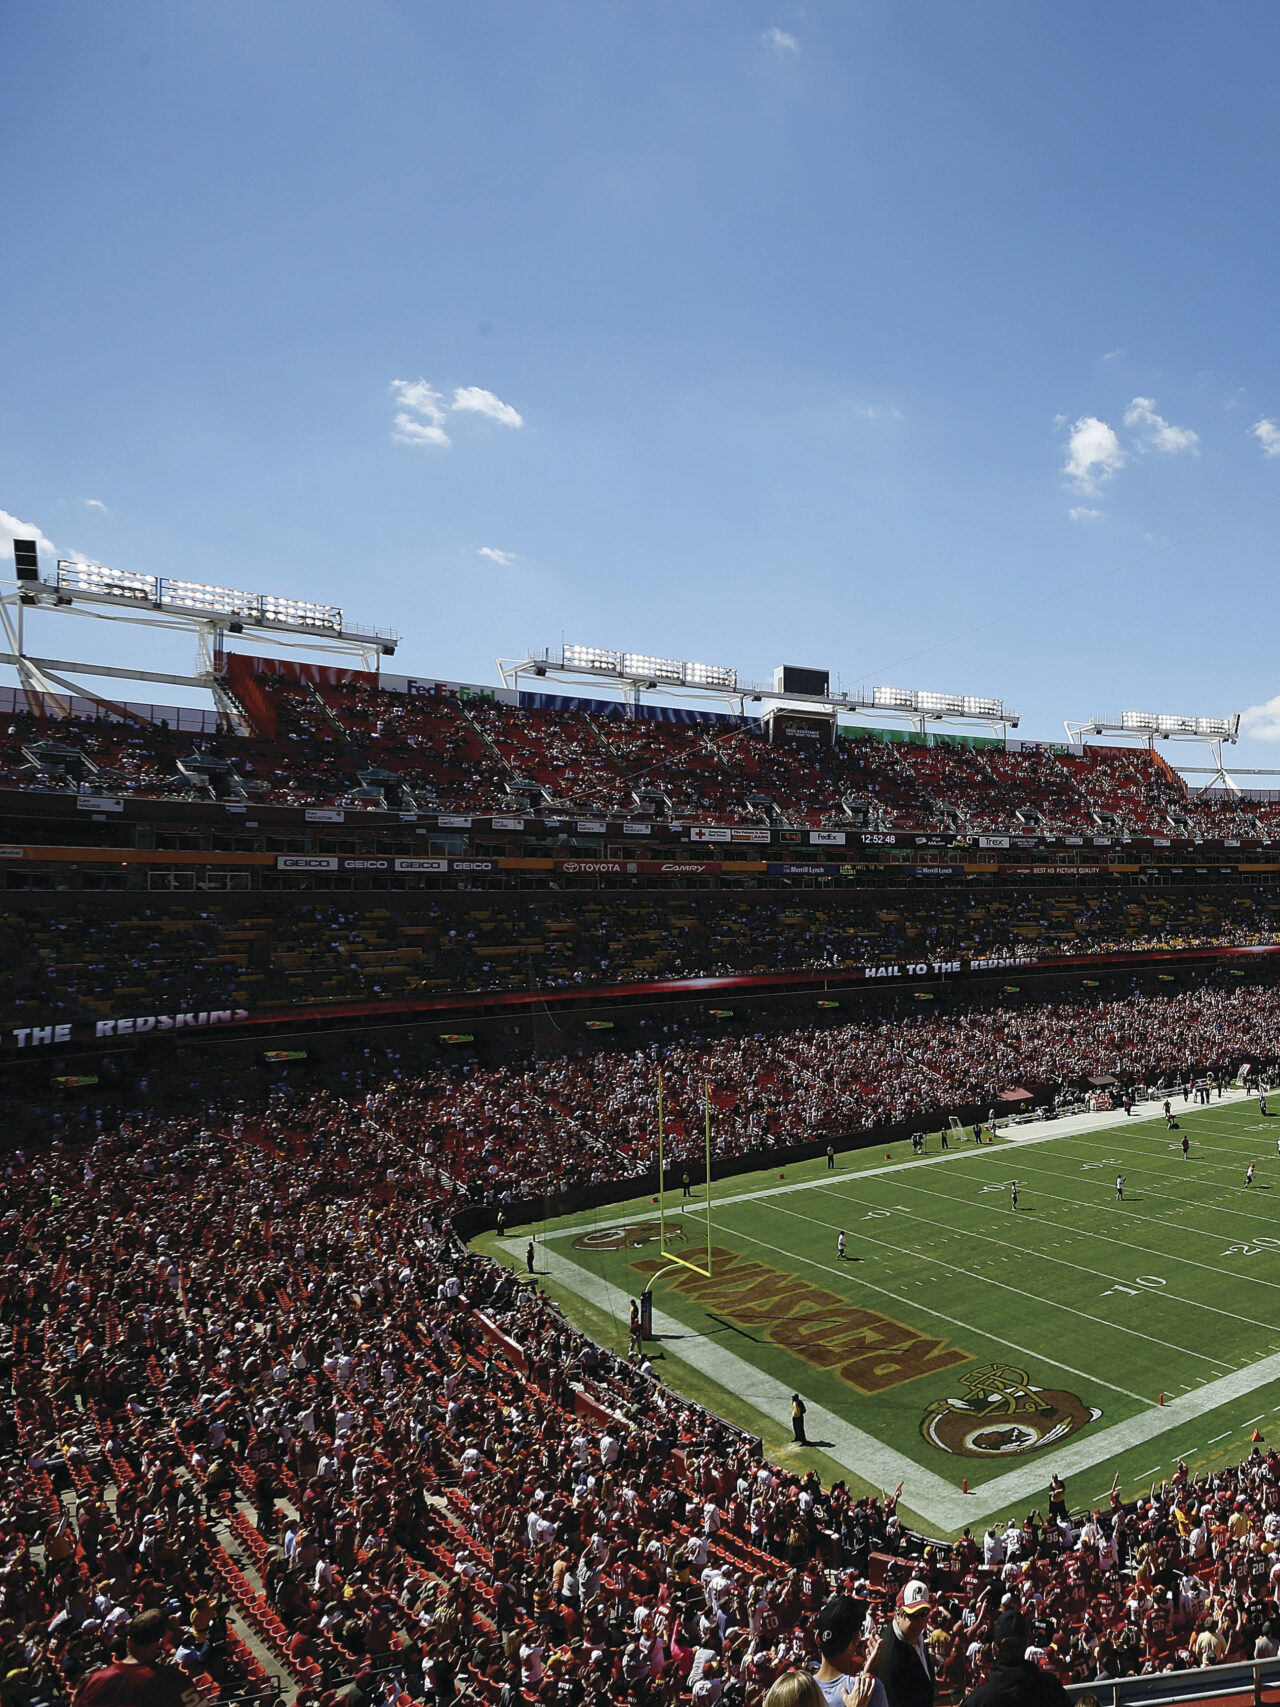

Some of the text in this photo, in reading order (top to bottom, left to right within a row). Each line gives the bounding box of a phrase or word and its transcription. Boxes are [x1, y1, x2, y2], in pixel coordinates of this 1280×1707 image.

[861, 834, 896, 843] 12:52:48
[985, 838, 1002, 846] Trex
[283, 859, 330, 868] GEICO
[344, 860, 388, 869] GEICO
[400, 860, 441, 870] GEICO
[453, 862, 492, 870] GEICO
[580, 863, 620, 872] TOYOTA
[661, 863, 706, 873] CAMRY
[865, 957, 1039, 978] HAIL TO THE REDSKINS
[13, 1008, 249, 1048] THE REDSKINS
[1108, 1275, 1167, 1297] 10
[629, 1244, 978, 1395] REDSKINS
[1252, 1562, 1265, 1575] 28
[1072, 1586, 1086, 1599] 44
